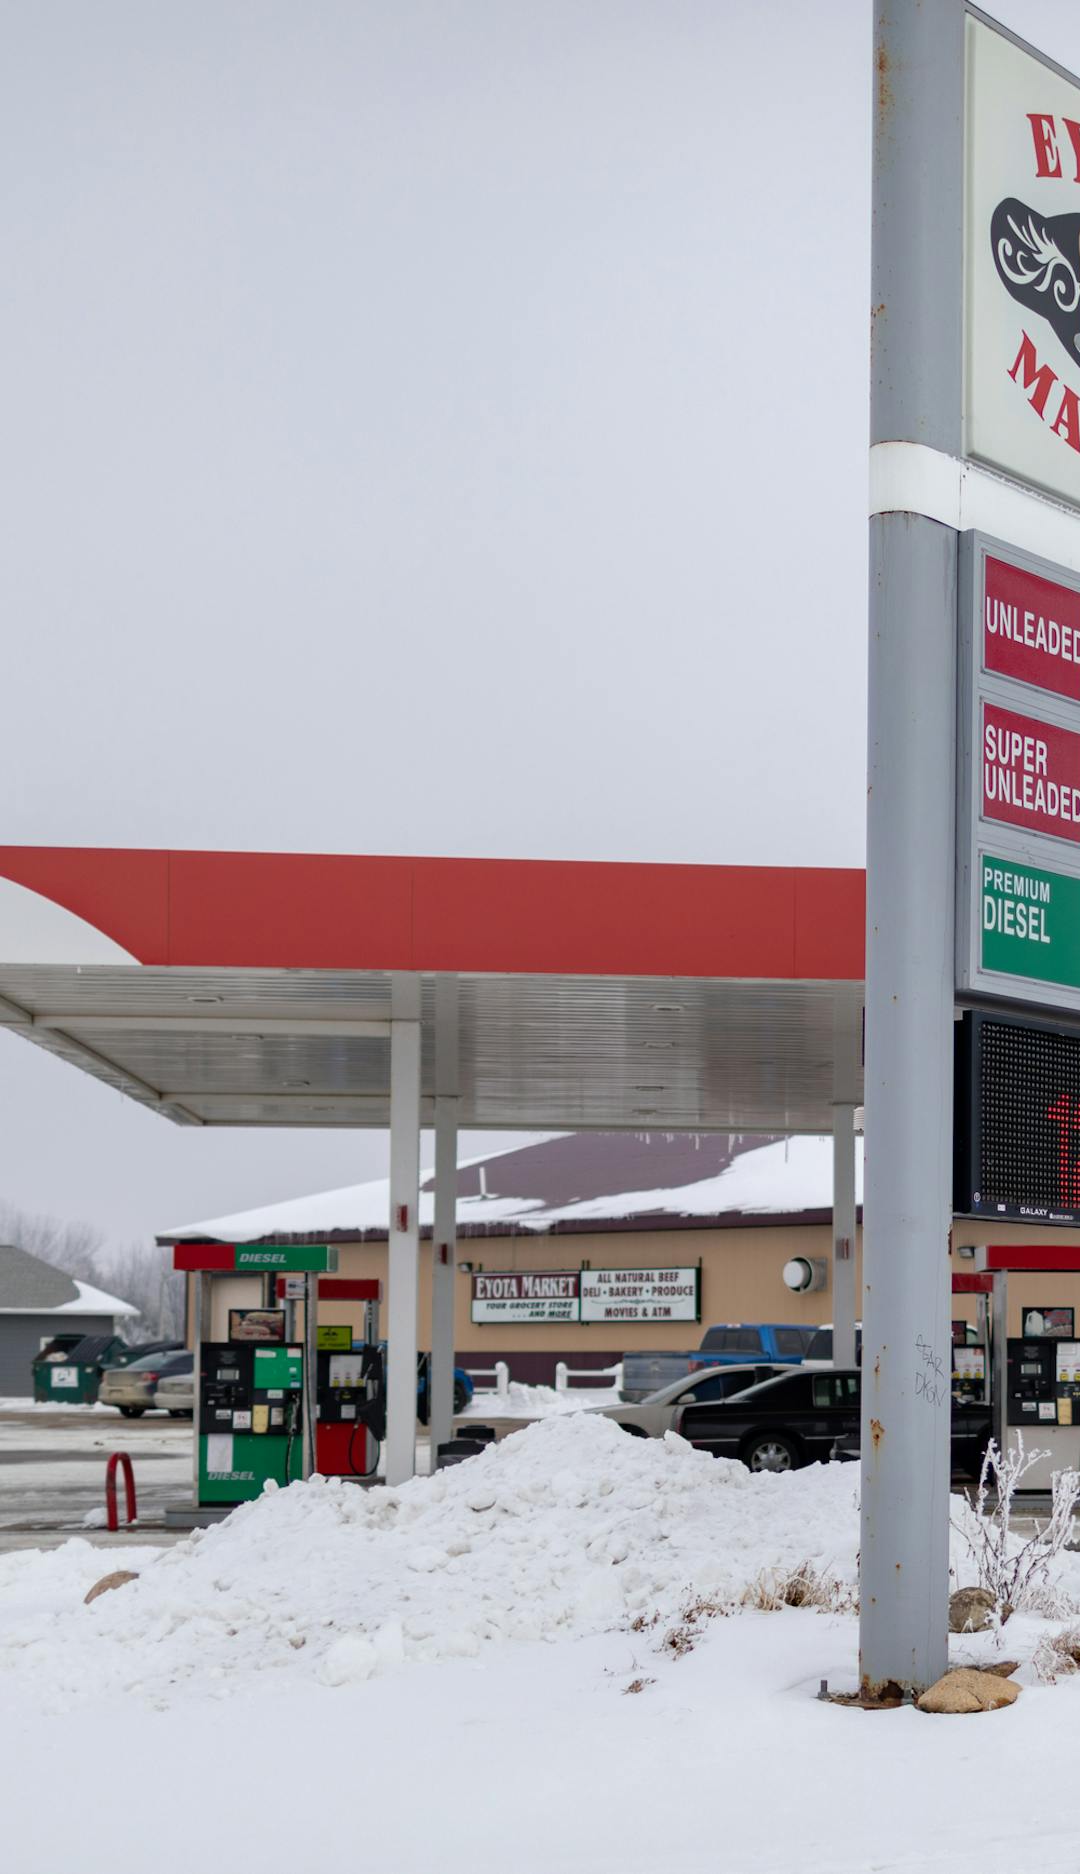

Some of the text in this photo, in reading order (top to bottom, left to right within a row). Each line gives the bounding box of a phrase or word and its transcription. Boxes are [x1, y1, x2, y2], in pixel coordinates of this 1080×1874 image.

[985, 724, 1048, 777] SUPER
[984, 867, 1050, 904] PREMIUM
[984, 896, 1050, 944] DIESEL
[1020, 1206, 1048, 1216] GALAXY
[239, 1253, 287, 1264] DIESEL
[597, 1271, 679, 1283] ALL NATURAL BEEF
[475, 1275, 576, 1298] EYOTA MARKET
[583, 1285, 694, 1297] DELI BAKERY PRODUCE
[509, 1301, 546, 1310] GROCERY
[548, 1301, 573, 1309] STORE
[547, 1310, 572, 1318] MORE
[604, 1306, 672, 1317] MOVIES & ATM
[207, 1471, 256, 1481] DIESEL
